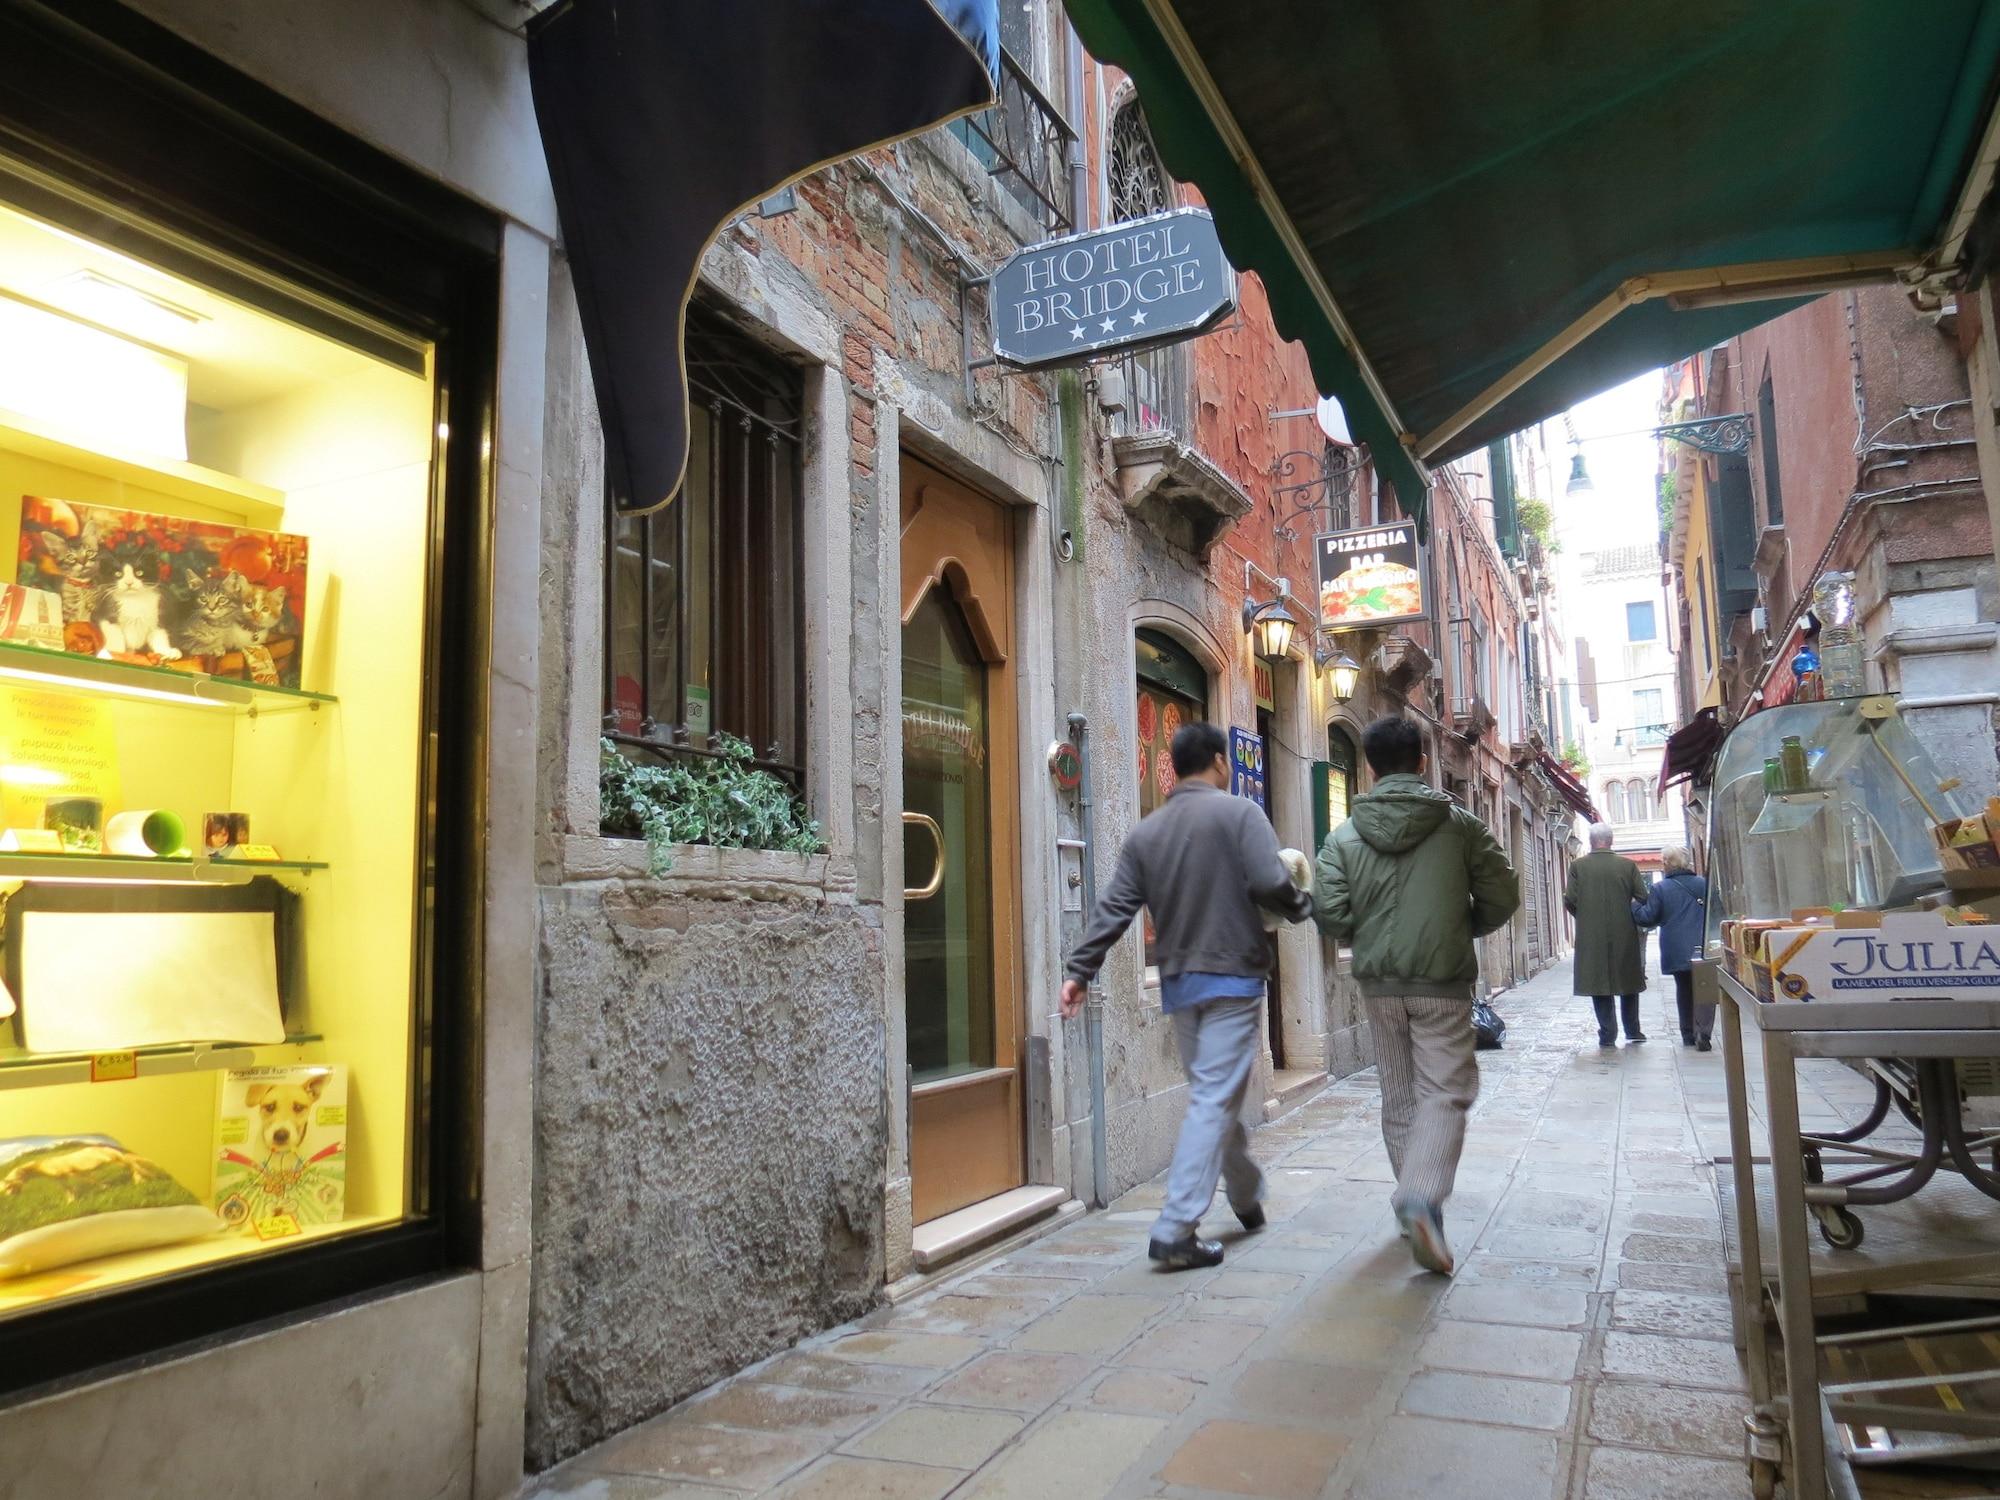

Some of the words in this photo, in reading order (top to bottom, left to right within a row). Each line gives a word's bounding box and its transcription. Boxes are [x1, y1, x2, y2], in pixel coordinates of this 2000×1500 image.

[1021, 225, 1192, 294] HOTEL
[1013, 259, 1205, 334] BRIDGE
[1326, 530, 1408, 554] PIZZERIA
[1350, 553, 1386, 573] BAR
[1829, 936, 2000, 976] JULIA
[1835, 980, 1849, 988] LA
[1849, 979, 1878, 988] MELA
[1878, 979, 1895, 987] DEL
[1897, 978, 1927, 987] FRIULI
[1927, 977, 1970, 986] VENEZIA
